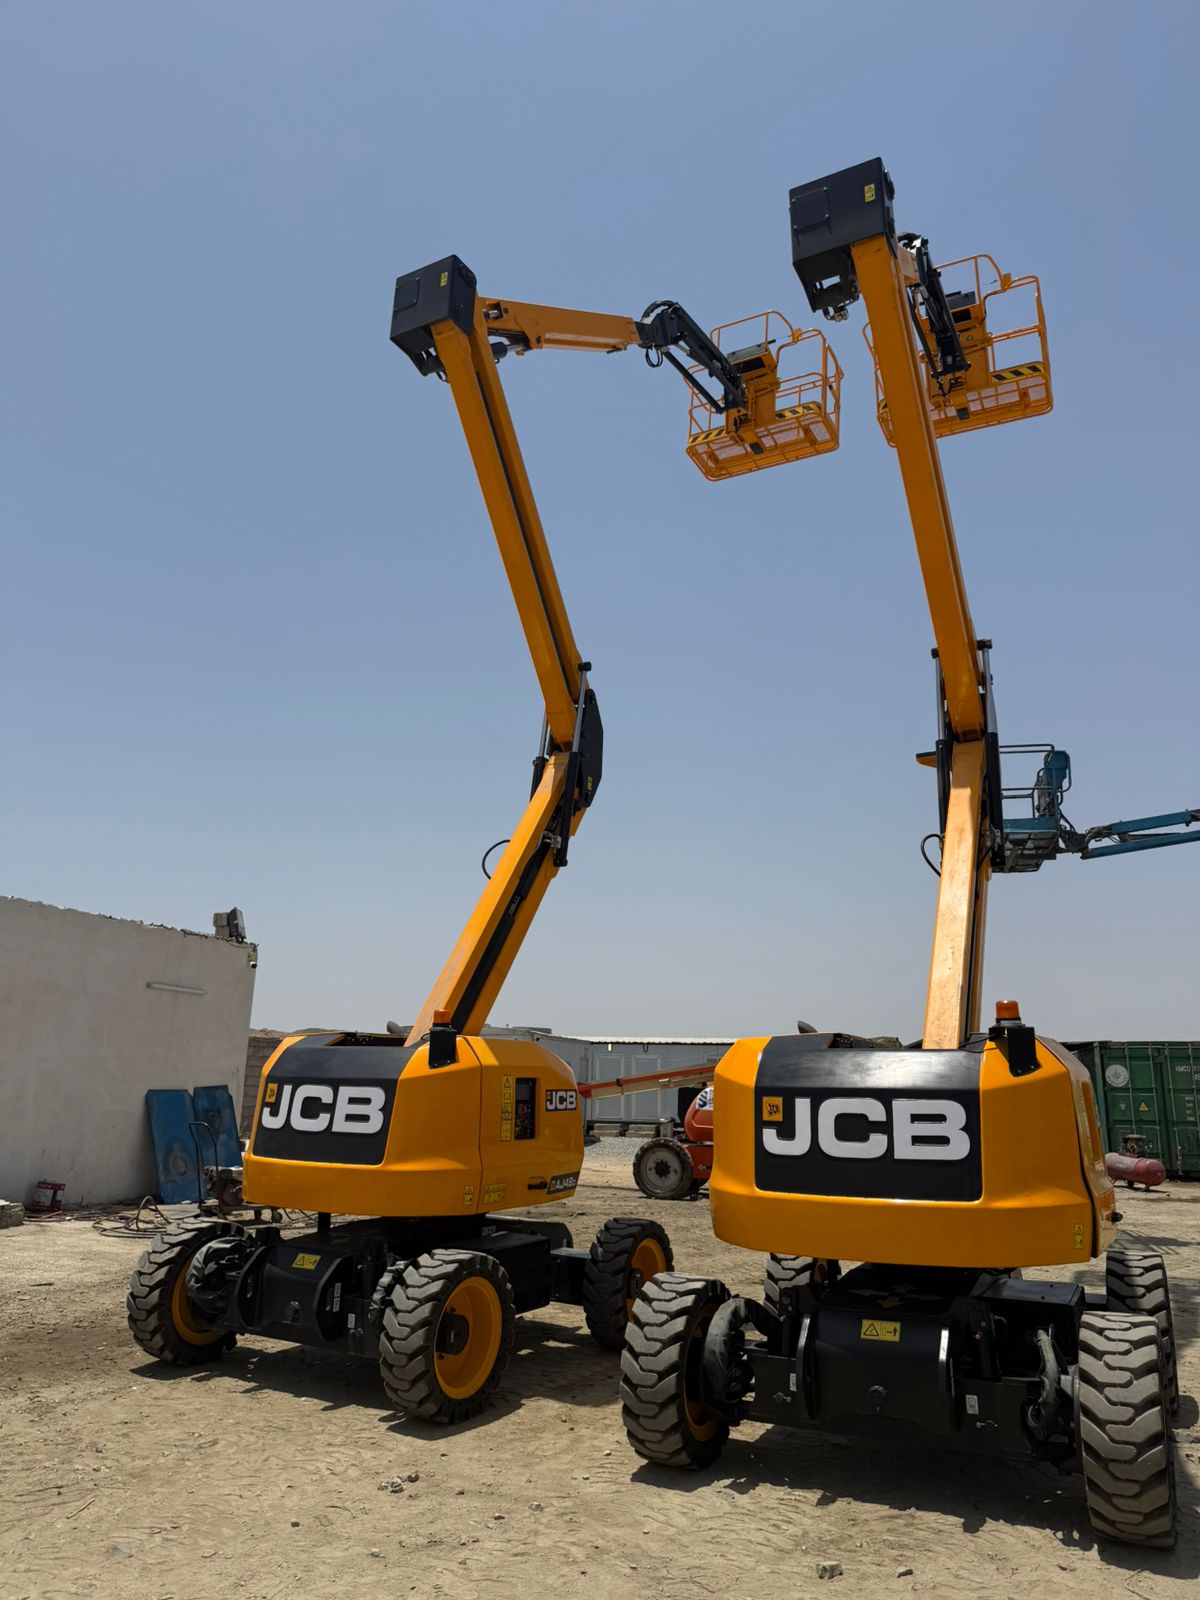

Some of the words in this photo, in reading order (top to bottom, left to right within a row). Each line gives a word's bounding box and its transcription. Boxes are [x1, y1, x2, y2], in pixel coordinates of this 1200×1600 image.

[261, 1084, 386, 1134] JCB
[547, 1091, 576, 1109] JCB
[762, 1096, 971, 1161] JCB
